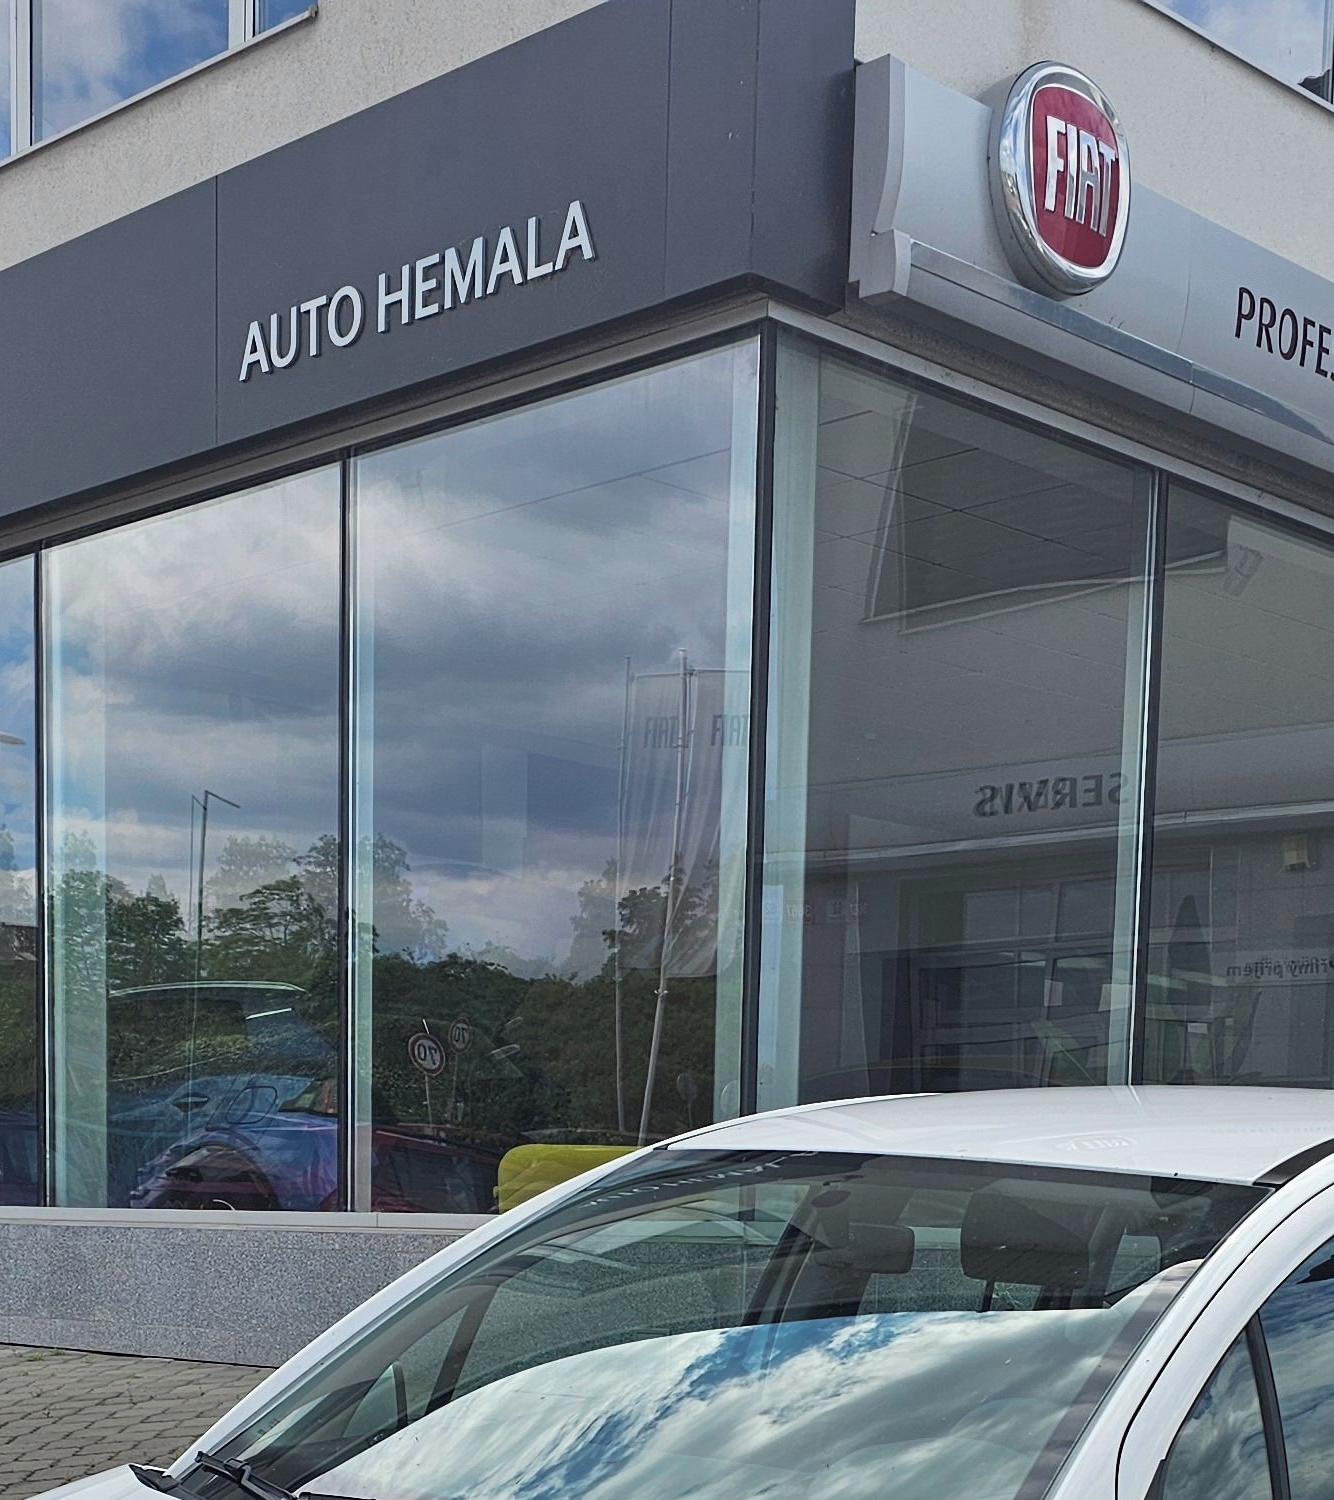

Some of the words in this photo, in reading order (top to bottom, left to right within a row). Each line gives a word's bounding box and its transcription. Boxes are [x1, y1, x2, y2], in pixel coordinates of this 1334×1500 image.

[1044, 115, 1116, 237] FIAT
[238, 285, 365, 382] AUTO
[377, 200, 595, 333] HEMALA
